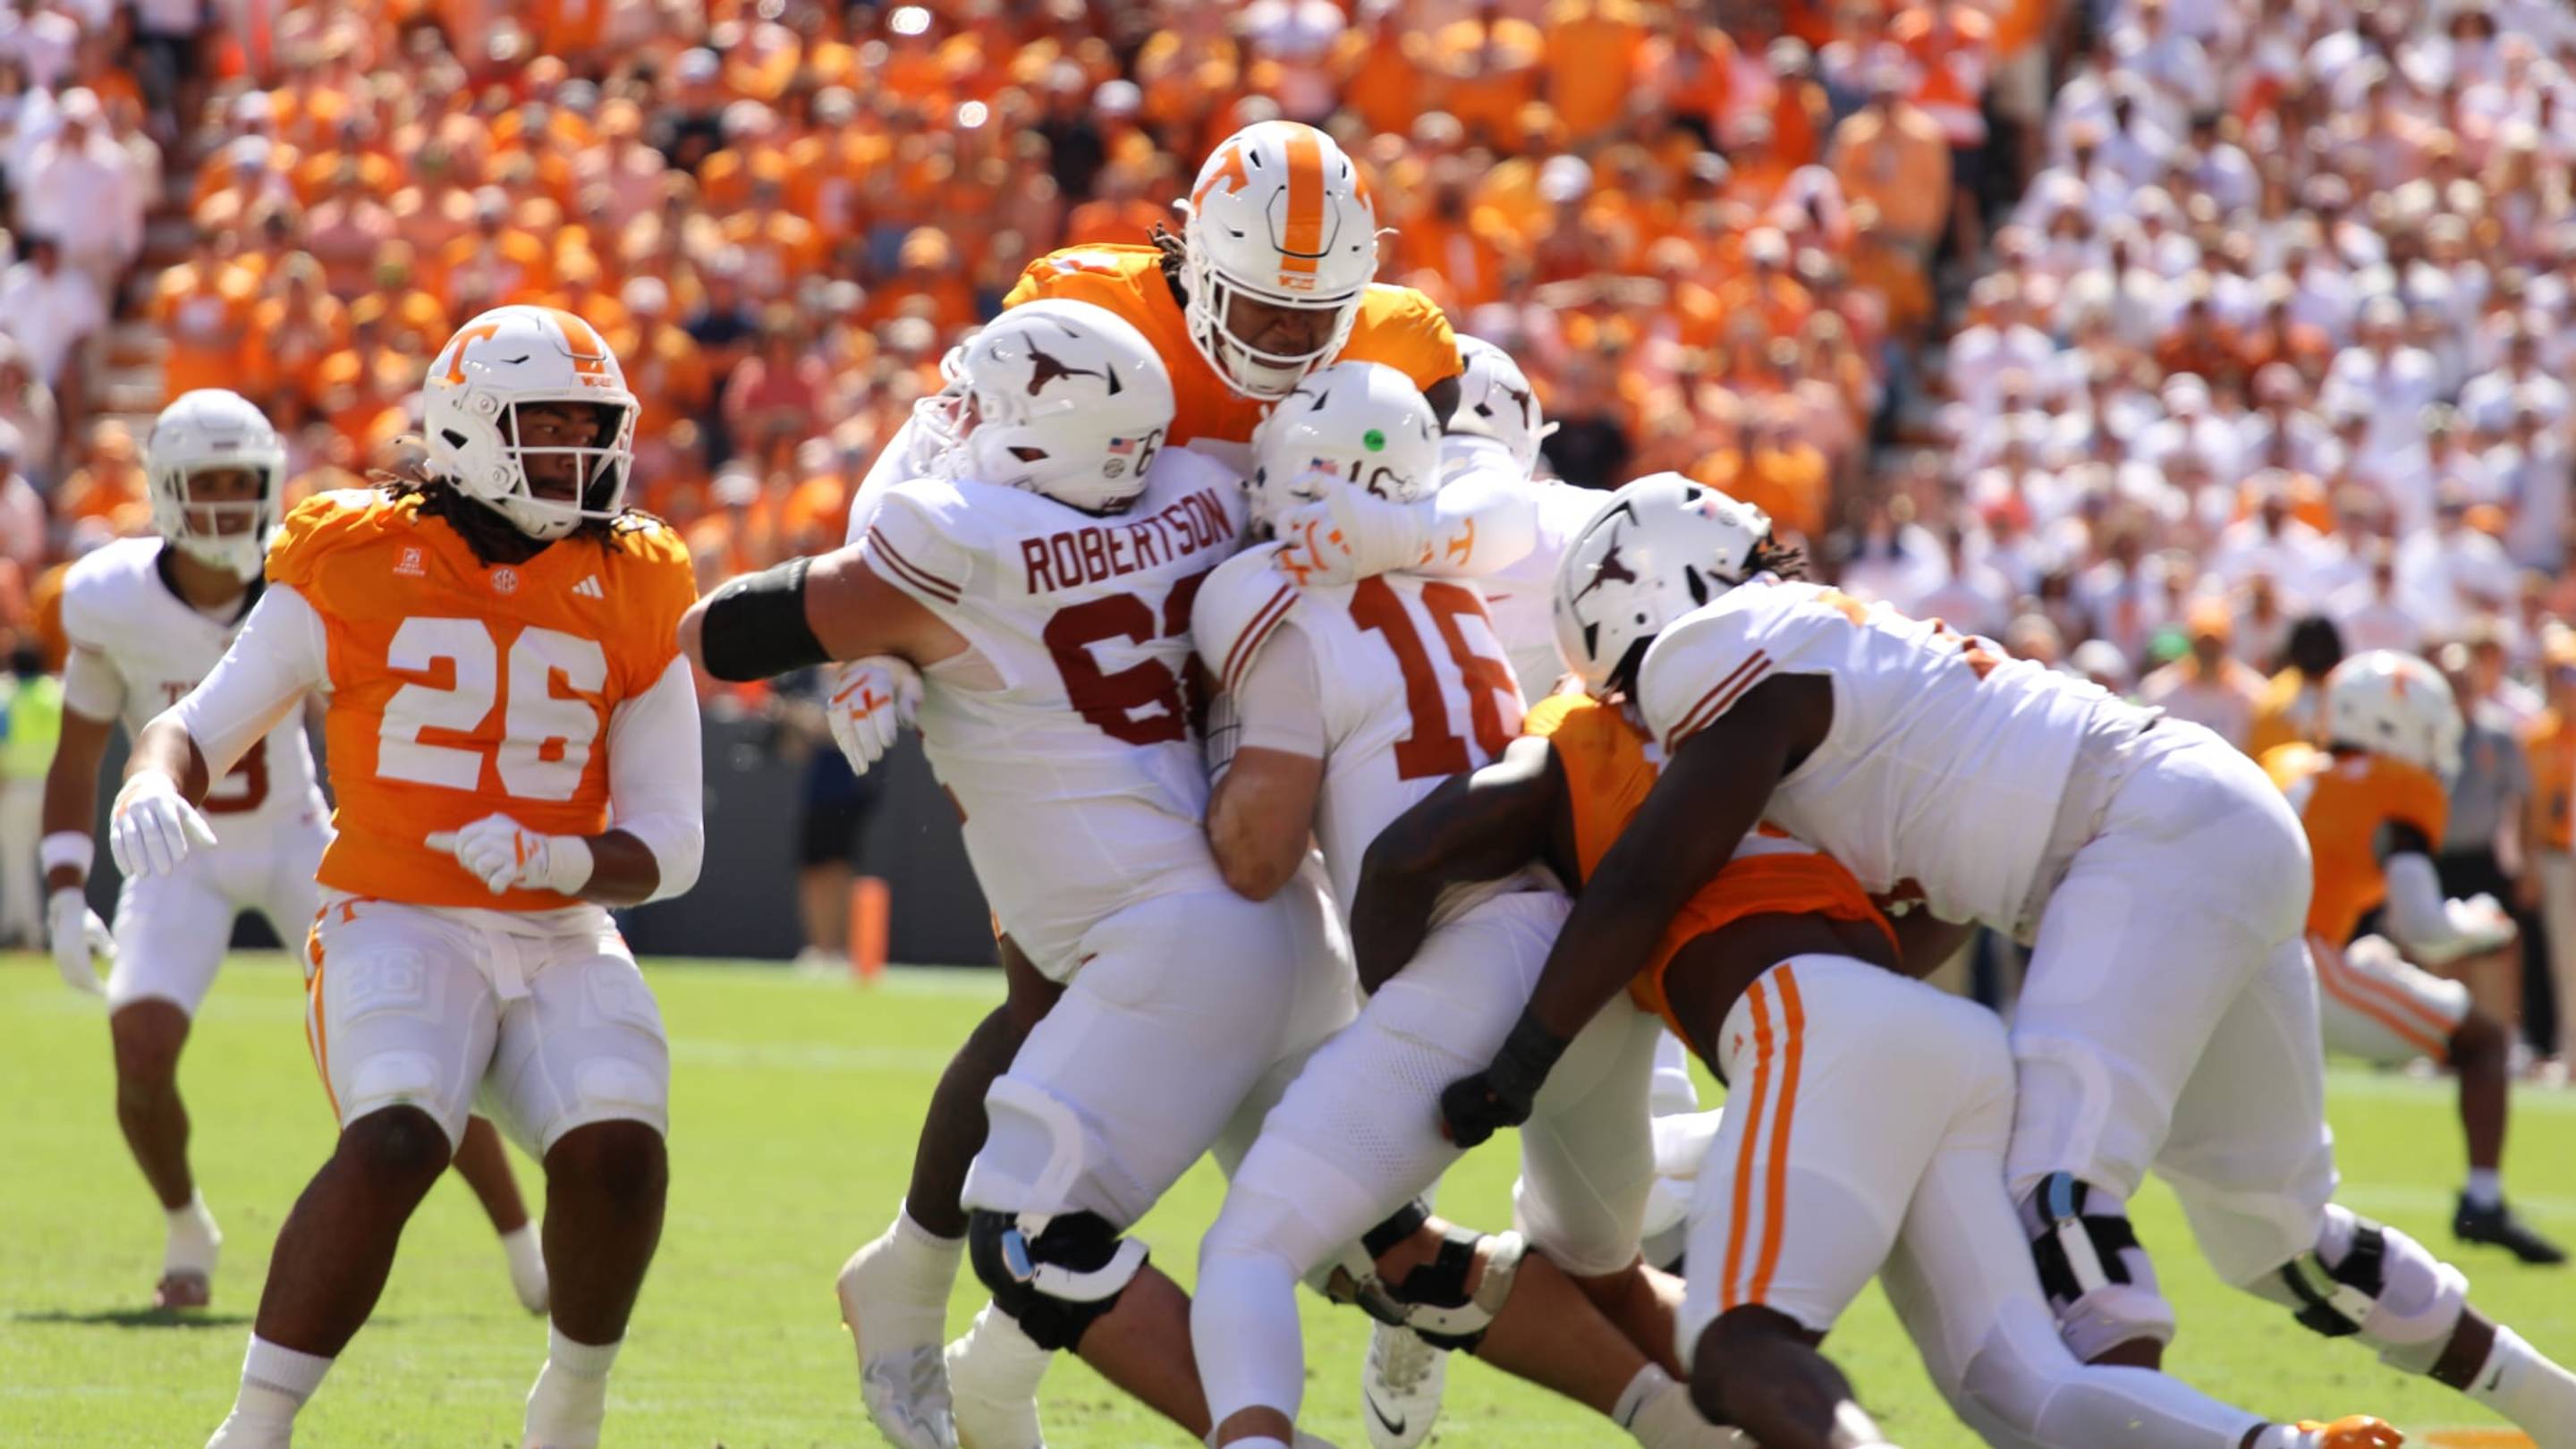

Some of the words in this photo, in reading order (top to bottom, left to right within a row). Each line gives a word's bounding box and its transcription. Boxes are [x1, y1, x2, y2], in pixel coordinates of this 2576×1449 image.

[1020, 488, 1234, 595] ROBERTSON
[376, 615, 608, 801] 26
[1349, 574, 1522, 781] 16
